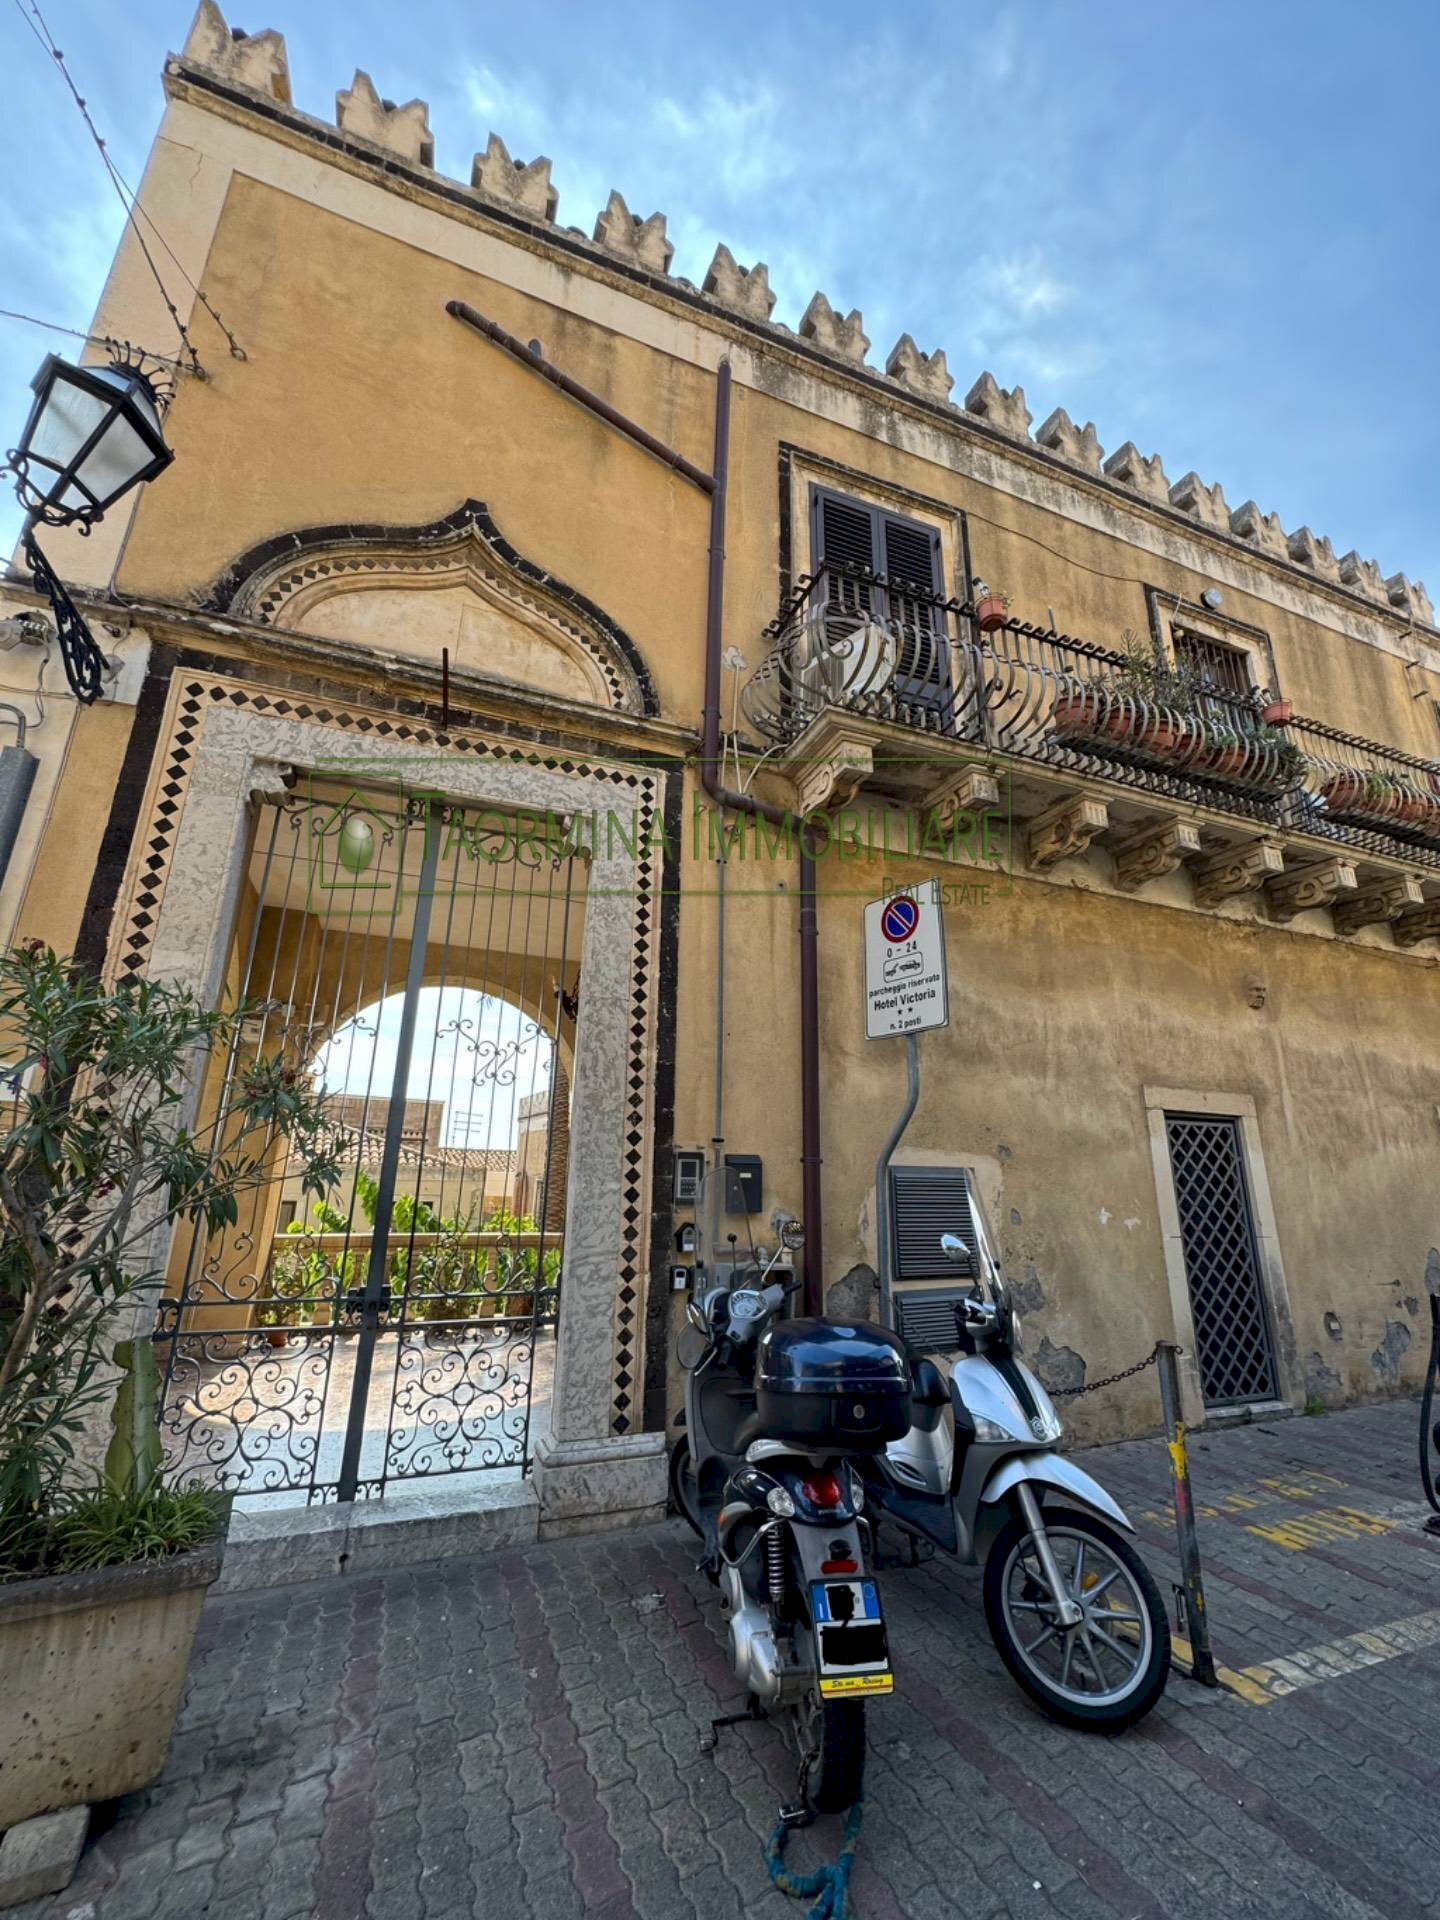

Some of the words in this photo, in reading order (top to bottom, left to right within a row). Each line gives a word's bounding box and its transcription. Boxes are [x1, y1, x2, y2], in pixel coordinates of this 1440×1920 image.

[906, 941, 917, 953] 24
[869, 982, 907, 999] parcheggio
[908, 973, 940, 988] riservato
[874, 996, 898, 1011] Hotel
[900, 988, 936, 1006] Victoria
[898, 1019, 903, 1029] 2
[904, 1016, 922, 1030] posti
